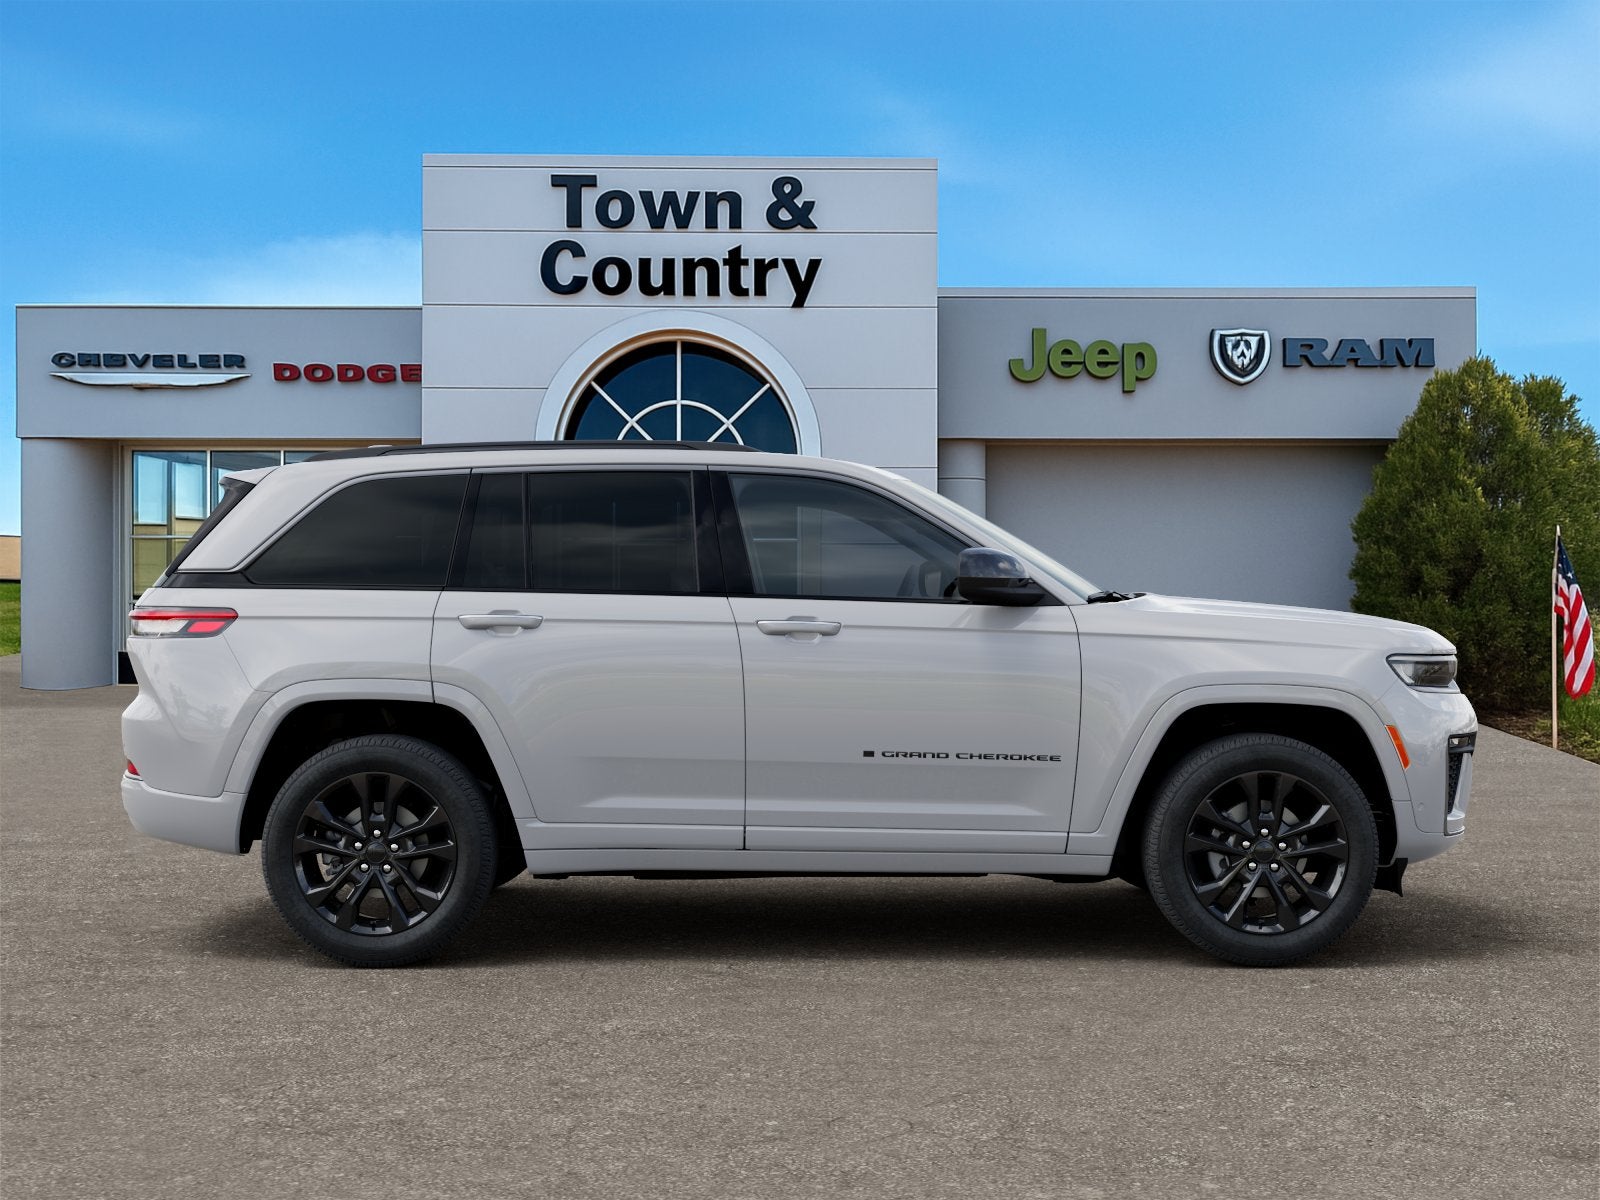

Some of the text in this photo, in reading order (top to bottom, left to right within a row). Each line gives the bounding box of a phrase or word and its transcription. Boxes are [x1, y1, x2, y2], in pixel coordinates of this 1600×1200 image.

[551, 174, 818, 230] Town &
[540, 239, 822, 308] Country
[273, 362, 422, 383] DODGE
[1009, 328, 1156, 392] Jeep
[1282, 337, 1435, 368] RAM
[881, 750, 1061, 762] GRAND CHEROKEE
